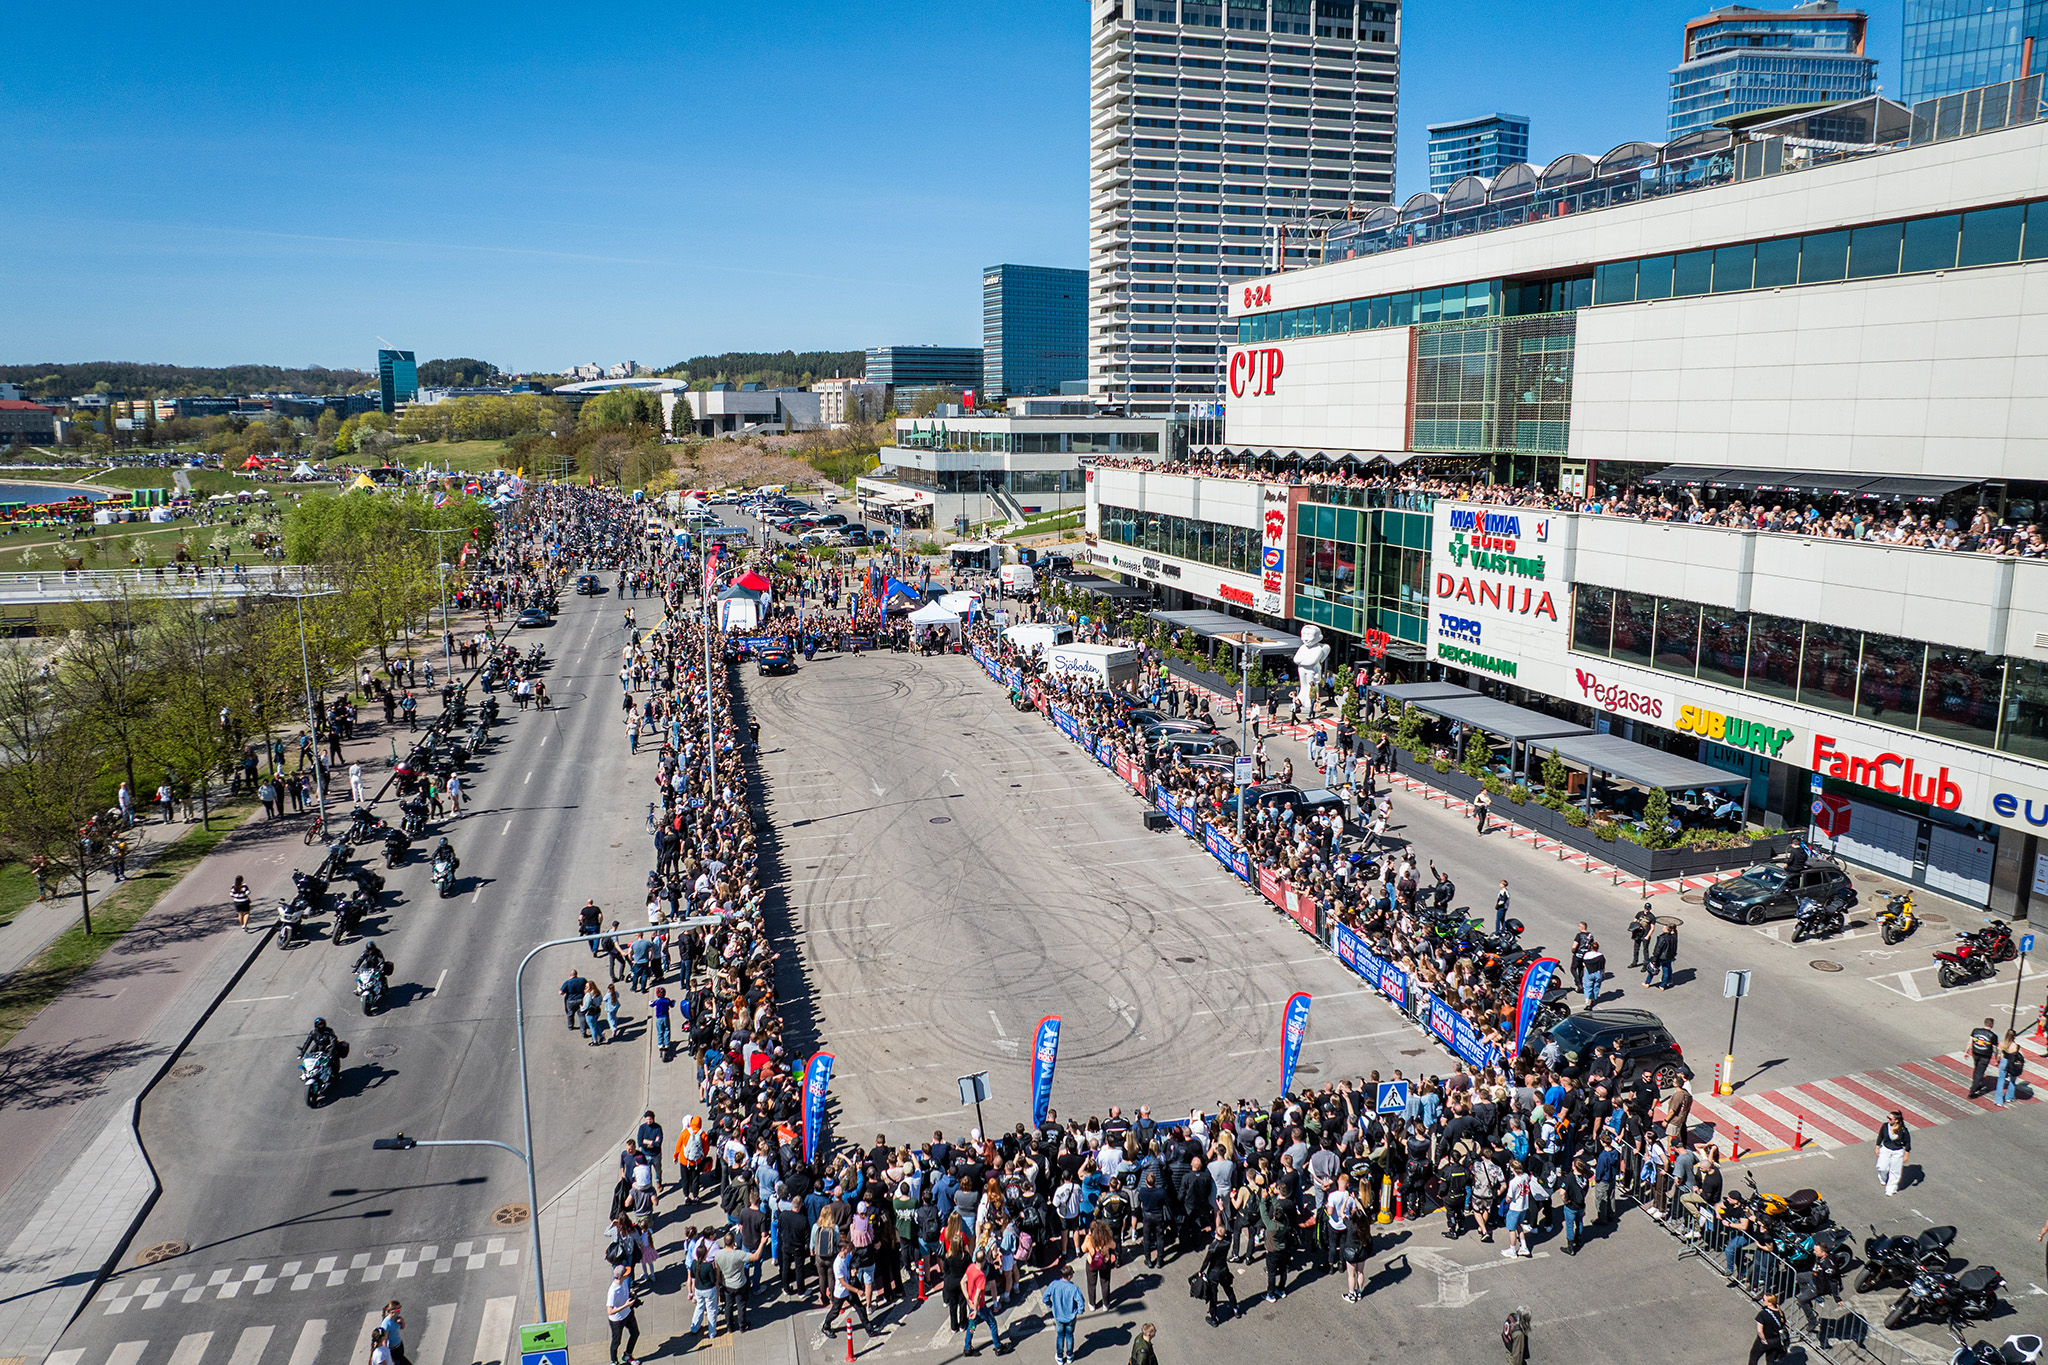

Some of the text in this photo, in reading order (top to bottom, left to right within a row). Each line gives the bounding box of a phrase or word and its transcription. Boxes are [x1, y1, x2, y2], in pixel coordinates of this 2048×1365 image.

[1244, 284, 1271, 308] 8-24
[1229, 348, 1284, 398] CUP
[1450, 510, 1521, 538] MAXIMA
[1471, 535, 1515, 554] EURO
[1470, 550, 1545, 580] VAISTINĖ
[1437, 572, 1557, 622] DANIJA
[1439, 613, 1481, 637] TOPO
[1438, 643, 1518, 679] DEICHMANN
[1582, 672, 1663, 719] Pegasas
[1675, 704, 1794, 756] SUBWAY
[1812, 734, 1963, 811] FamClub
[1381, 976, 1403, 1001] MOLY
[1382, 964, 1403, 987] LIQUI
[1432, 1001, 1454, 1029] LIQUI
[1432, 1014, 1453, 1042] MOLY
[1456, 1032, 1485, 1061] ADDITIVES
